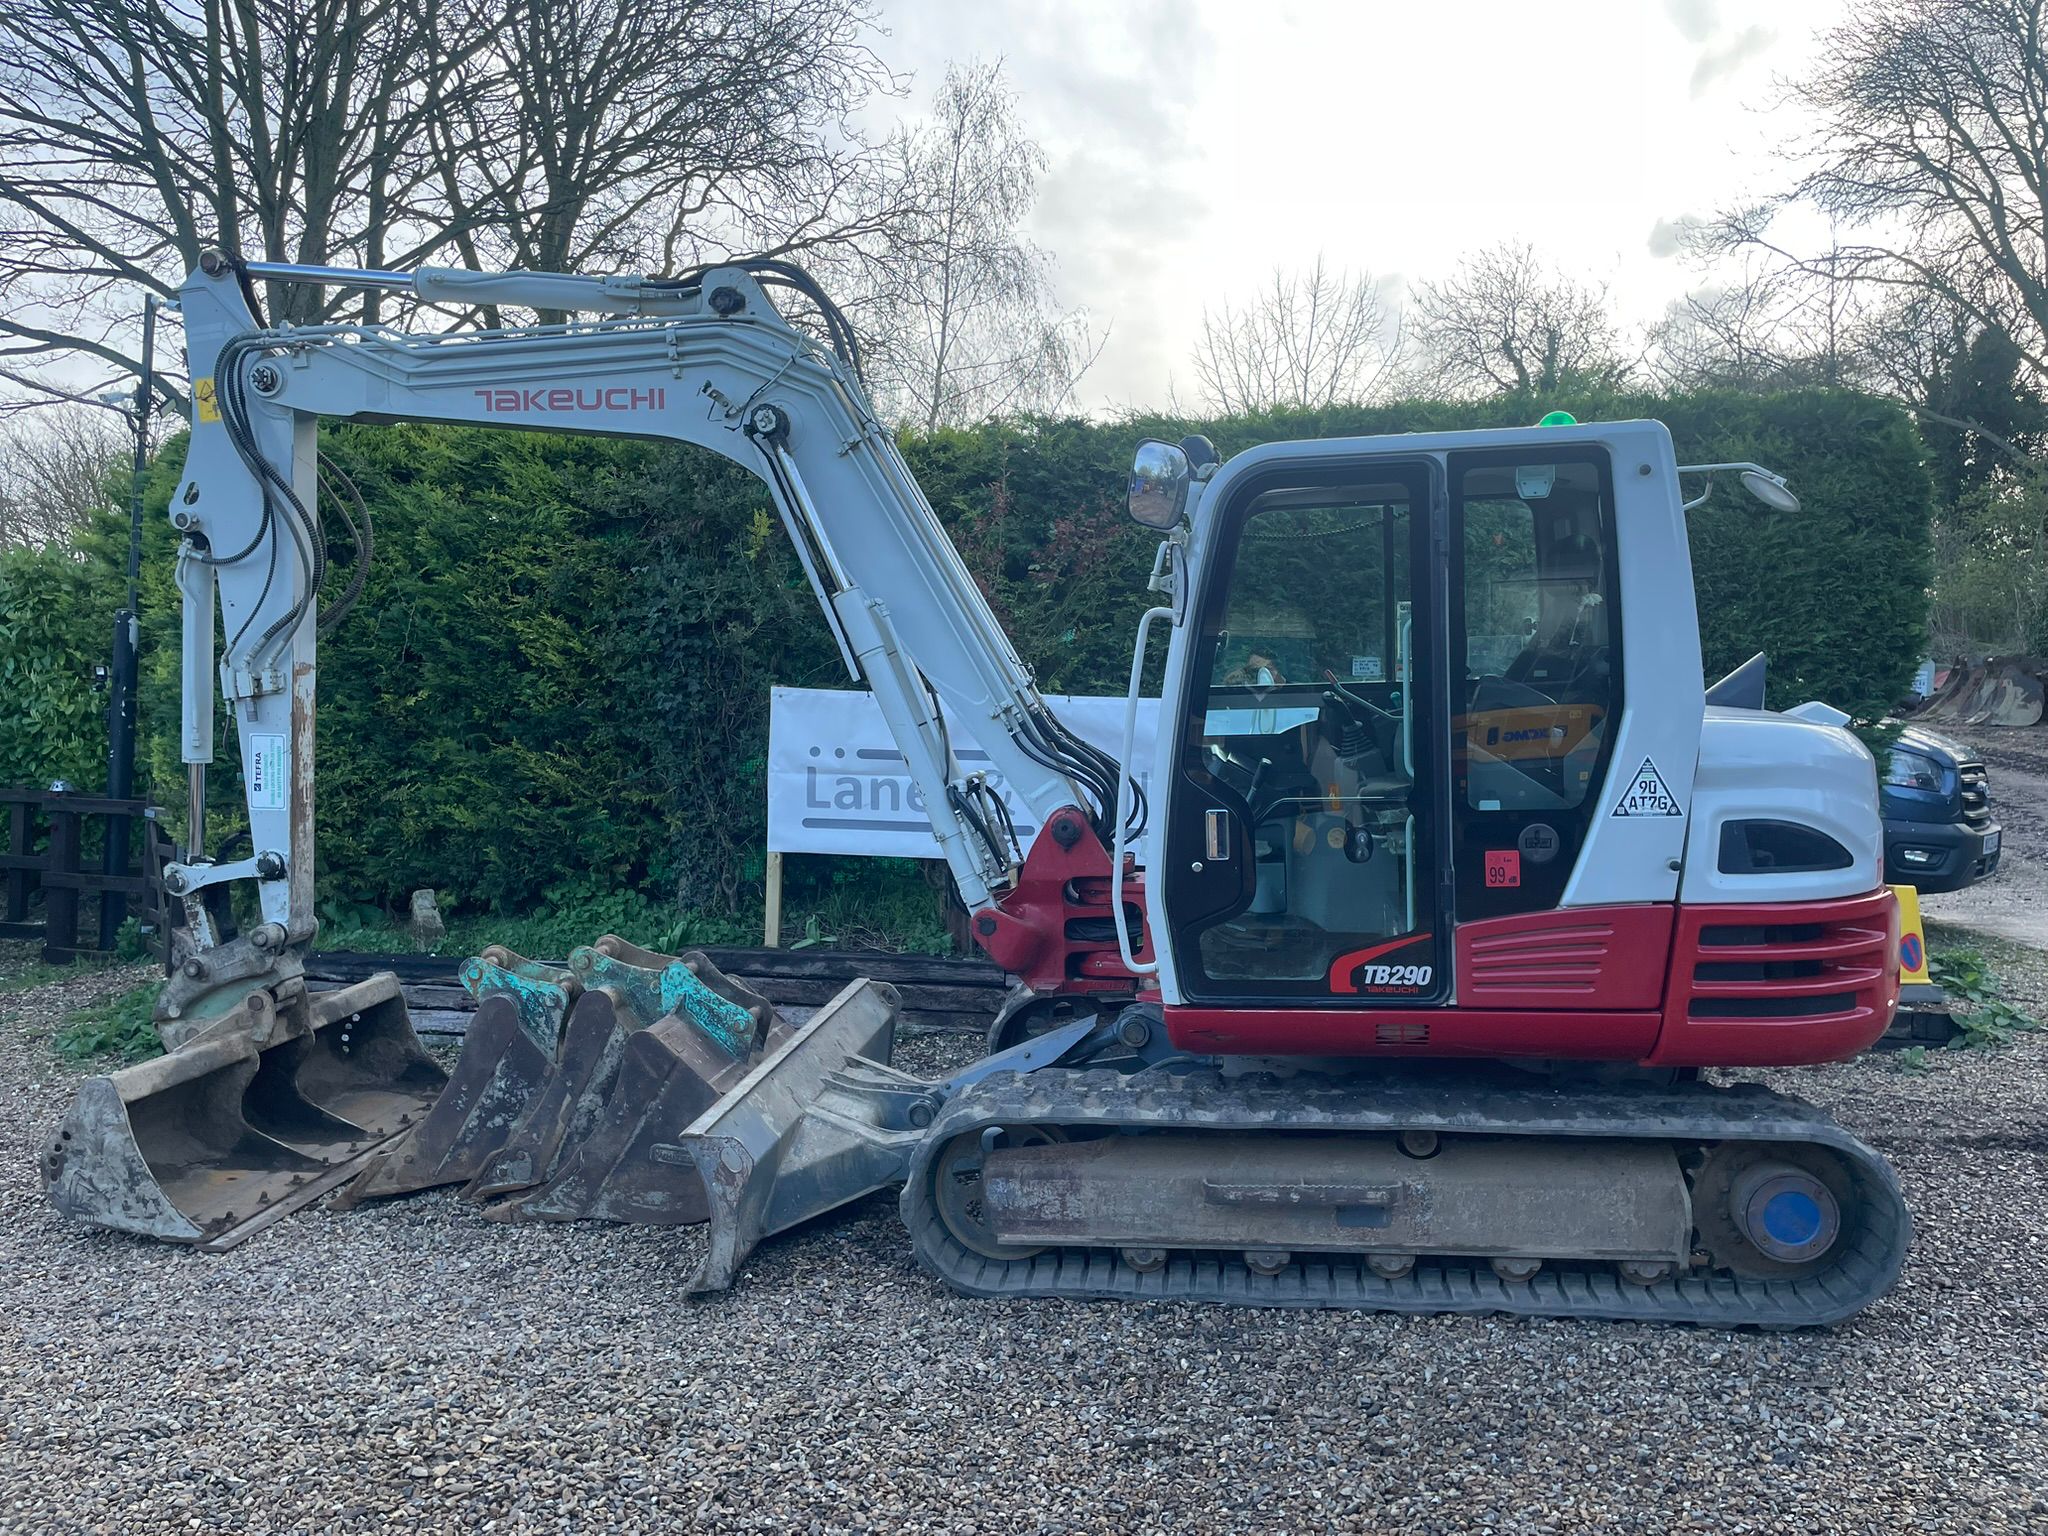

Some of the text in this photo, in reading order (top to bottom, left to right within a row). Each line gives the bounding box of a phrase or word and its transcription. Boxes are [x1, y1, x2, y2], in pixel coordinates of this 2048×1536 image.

[474, 388, 665, 412] TAKEUCHI
[1639, 780, 1657, 795] 90
[1629, 796, 1668, 810] AT7G
[1489, 867, 1505, 884] 99
[1364, 965, 1432, 986] TB290
[1365, 986, 1419, 994] TAKEUCHI
